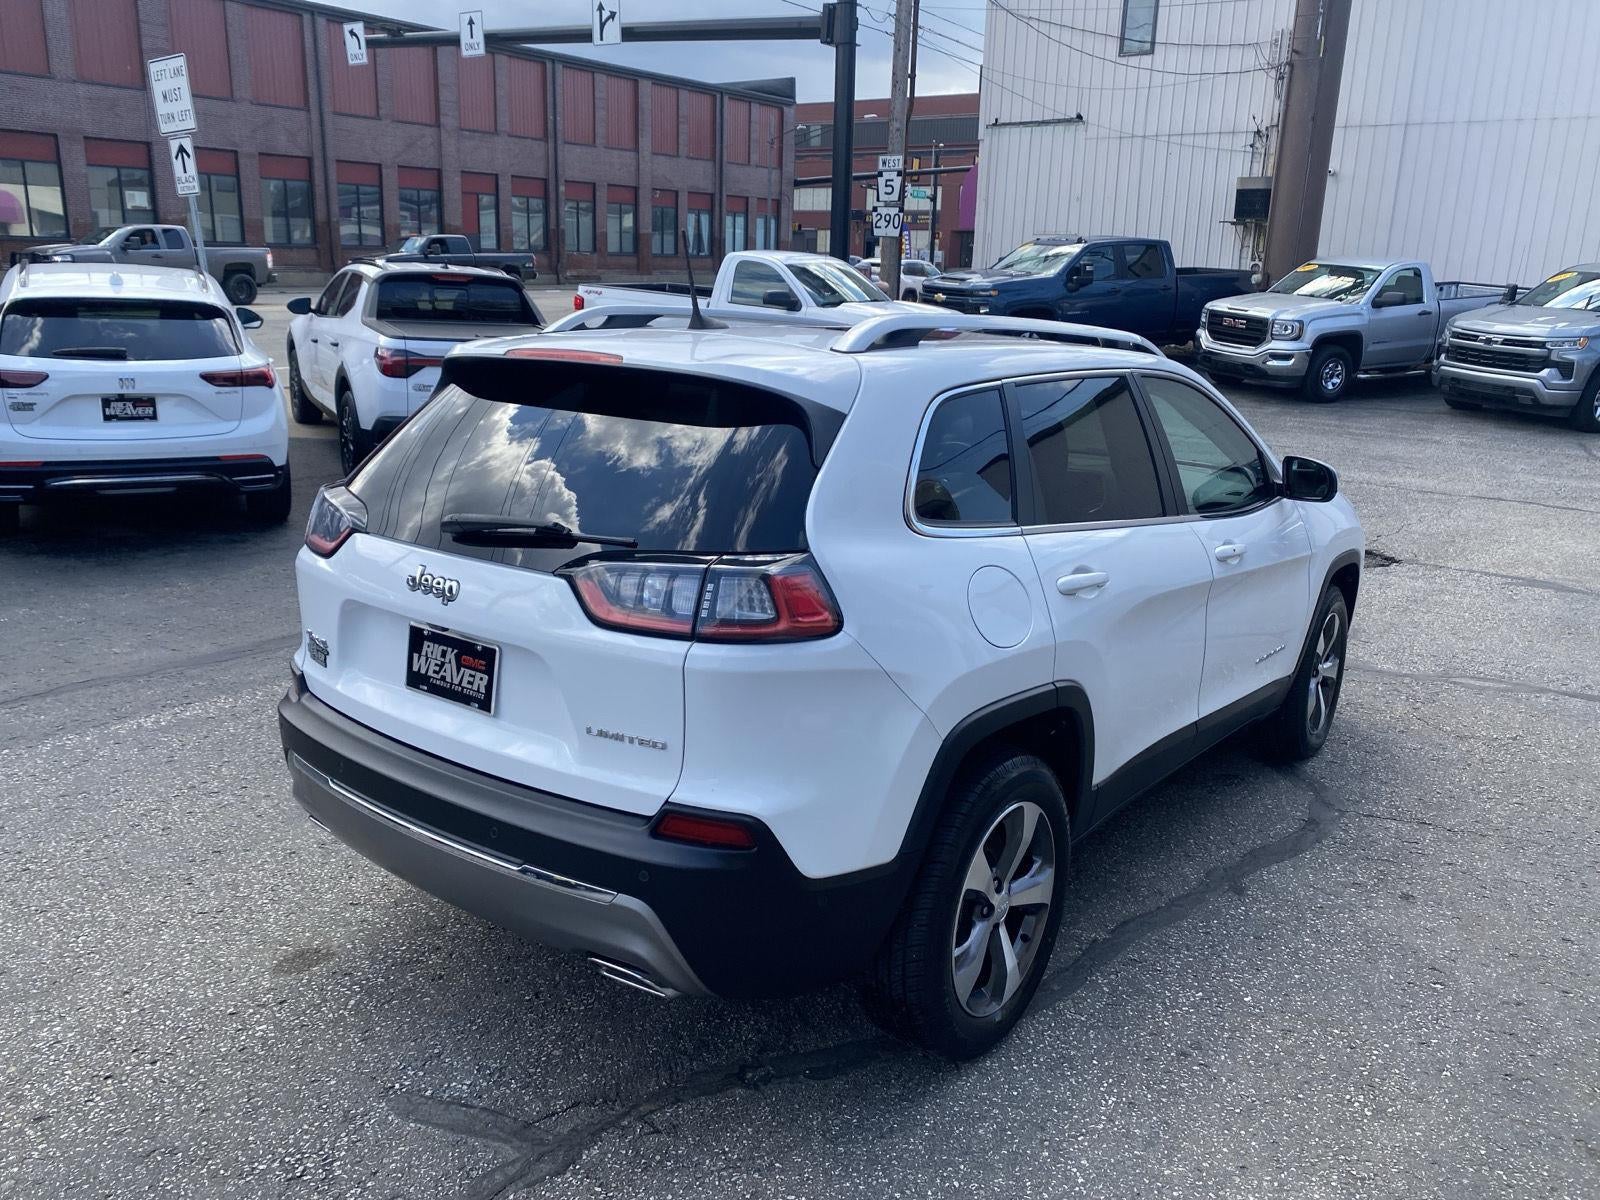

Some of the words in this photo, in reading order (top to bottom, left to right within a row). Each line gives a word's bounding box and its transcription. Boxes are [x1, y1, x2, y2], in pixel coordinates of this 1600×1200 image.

[465, 41, 480, 52] ONLY
[350, 52, 364, 61] ONLY
[153, 68, 167, 82] LEFT
[168, 65, 185, 79] LANE
[162, 87, 182, 104] MUST
[160, 112, 175, 125] TURN
[177, 109, 192, 122] LEFT
[881, 158, 901, 168] WEST
[177, 175, 197, 185] BLACK
[884, 179, 895, 196] 5
[874, 212, 901, 230] 290
[1222, 317, 1247, 328] GMC
[105, 406, 154, 416] WEAVER
[406, 564, 460, 606] Jeep
[421, 640, 458, 663] RICK
[461, 655, 487, 670] GMC
[412, 653, 489, 694] WEAVER
[429, 678, 450, 689] FAMOUS
[451, 683, 462, 692] FOR
[463, 688, 485, 700] SERVICE
[586, 726, 668, 750] LIMITED
